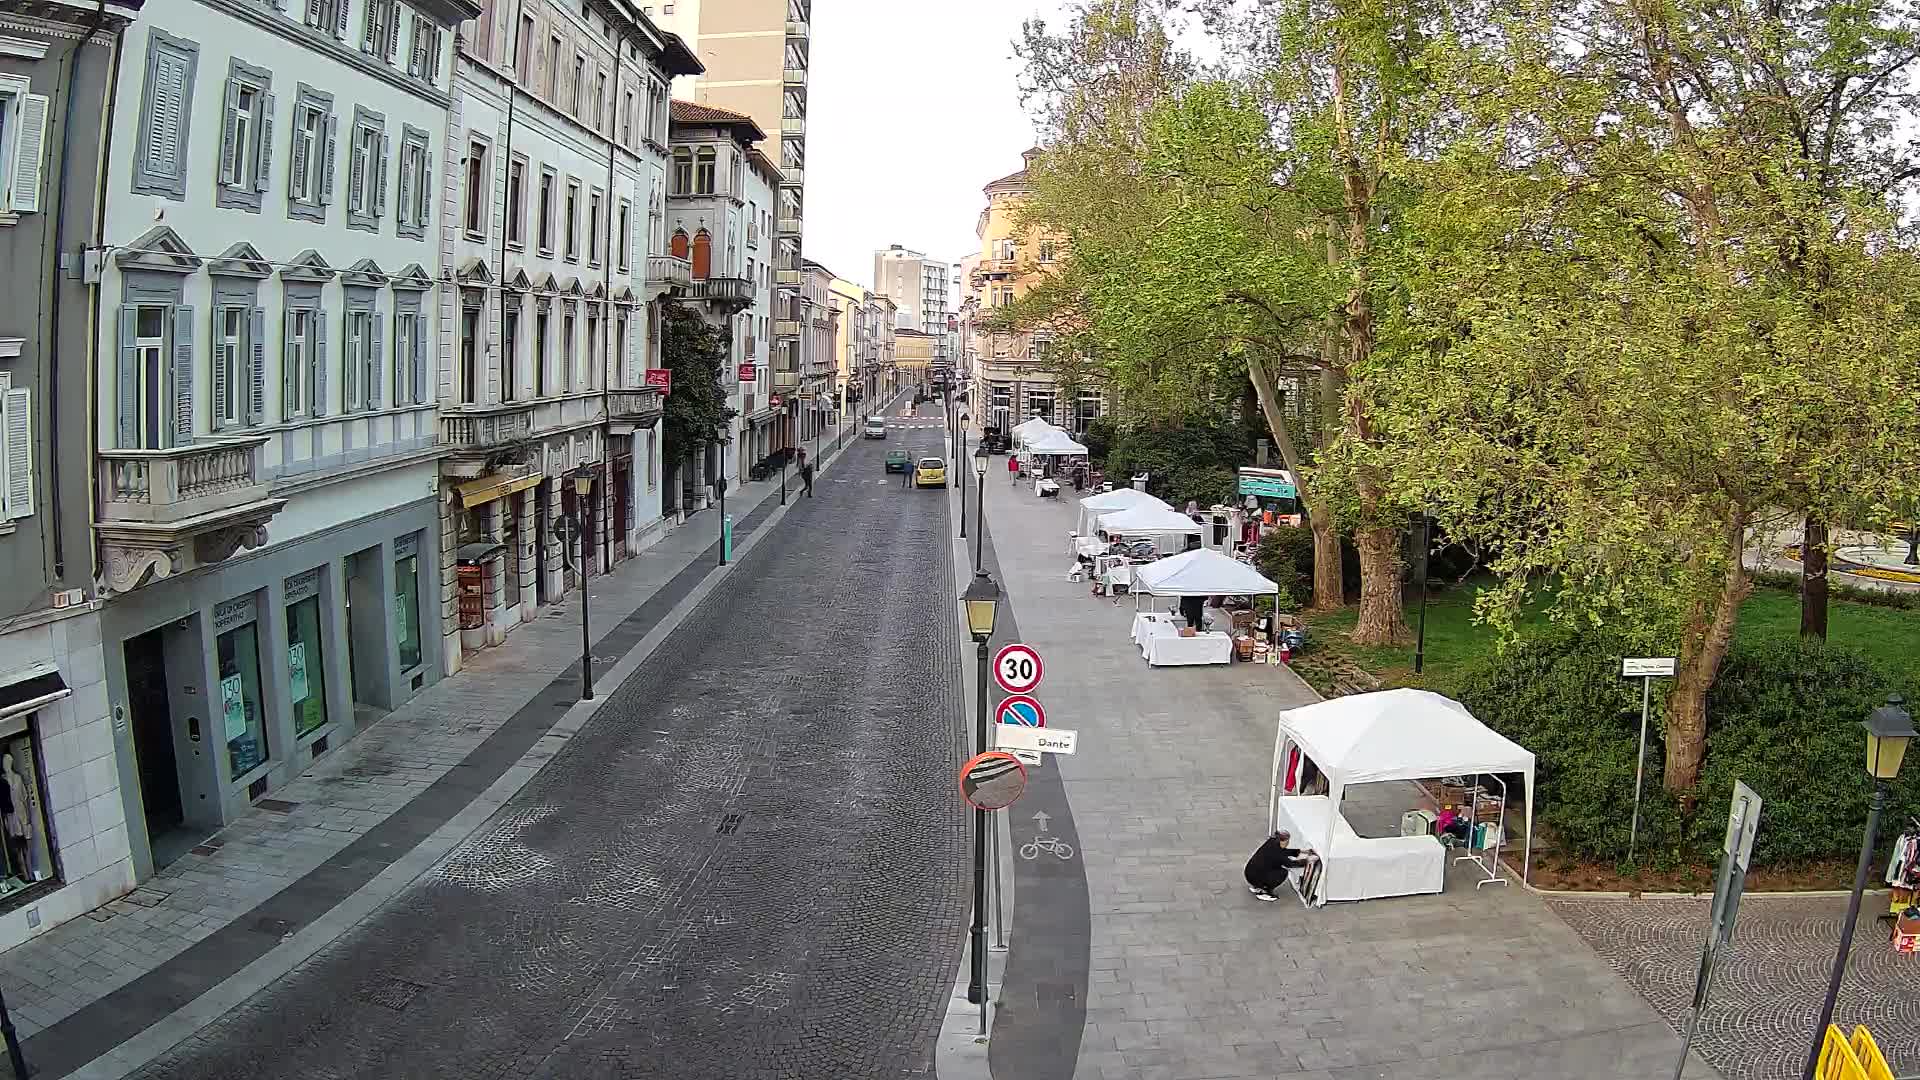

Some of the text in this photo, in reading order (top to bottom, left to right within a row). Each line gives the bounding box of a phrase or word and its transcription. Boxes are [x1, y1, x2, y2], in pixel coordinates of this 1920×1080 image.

[1006, 658, 1033, 680] 30
[223, 677, 241, 701] 130
[1038, 738, 1070, 749] Dante
